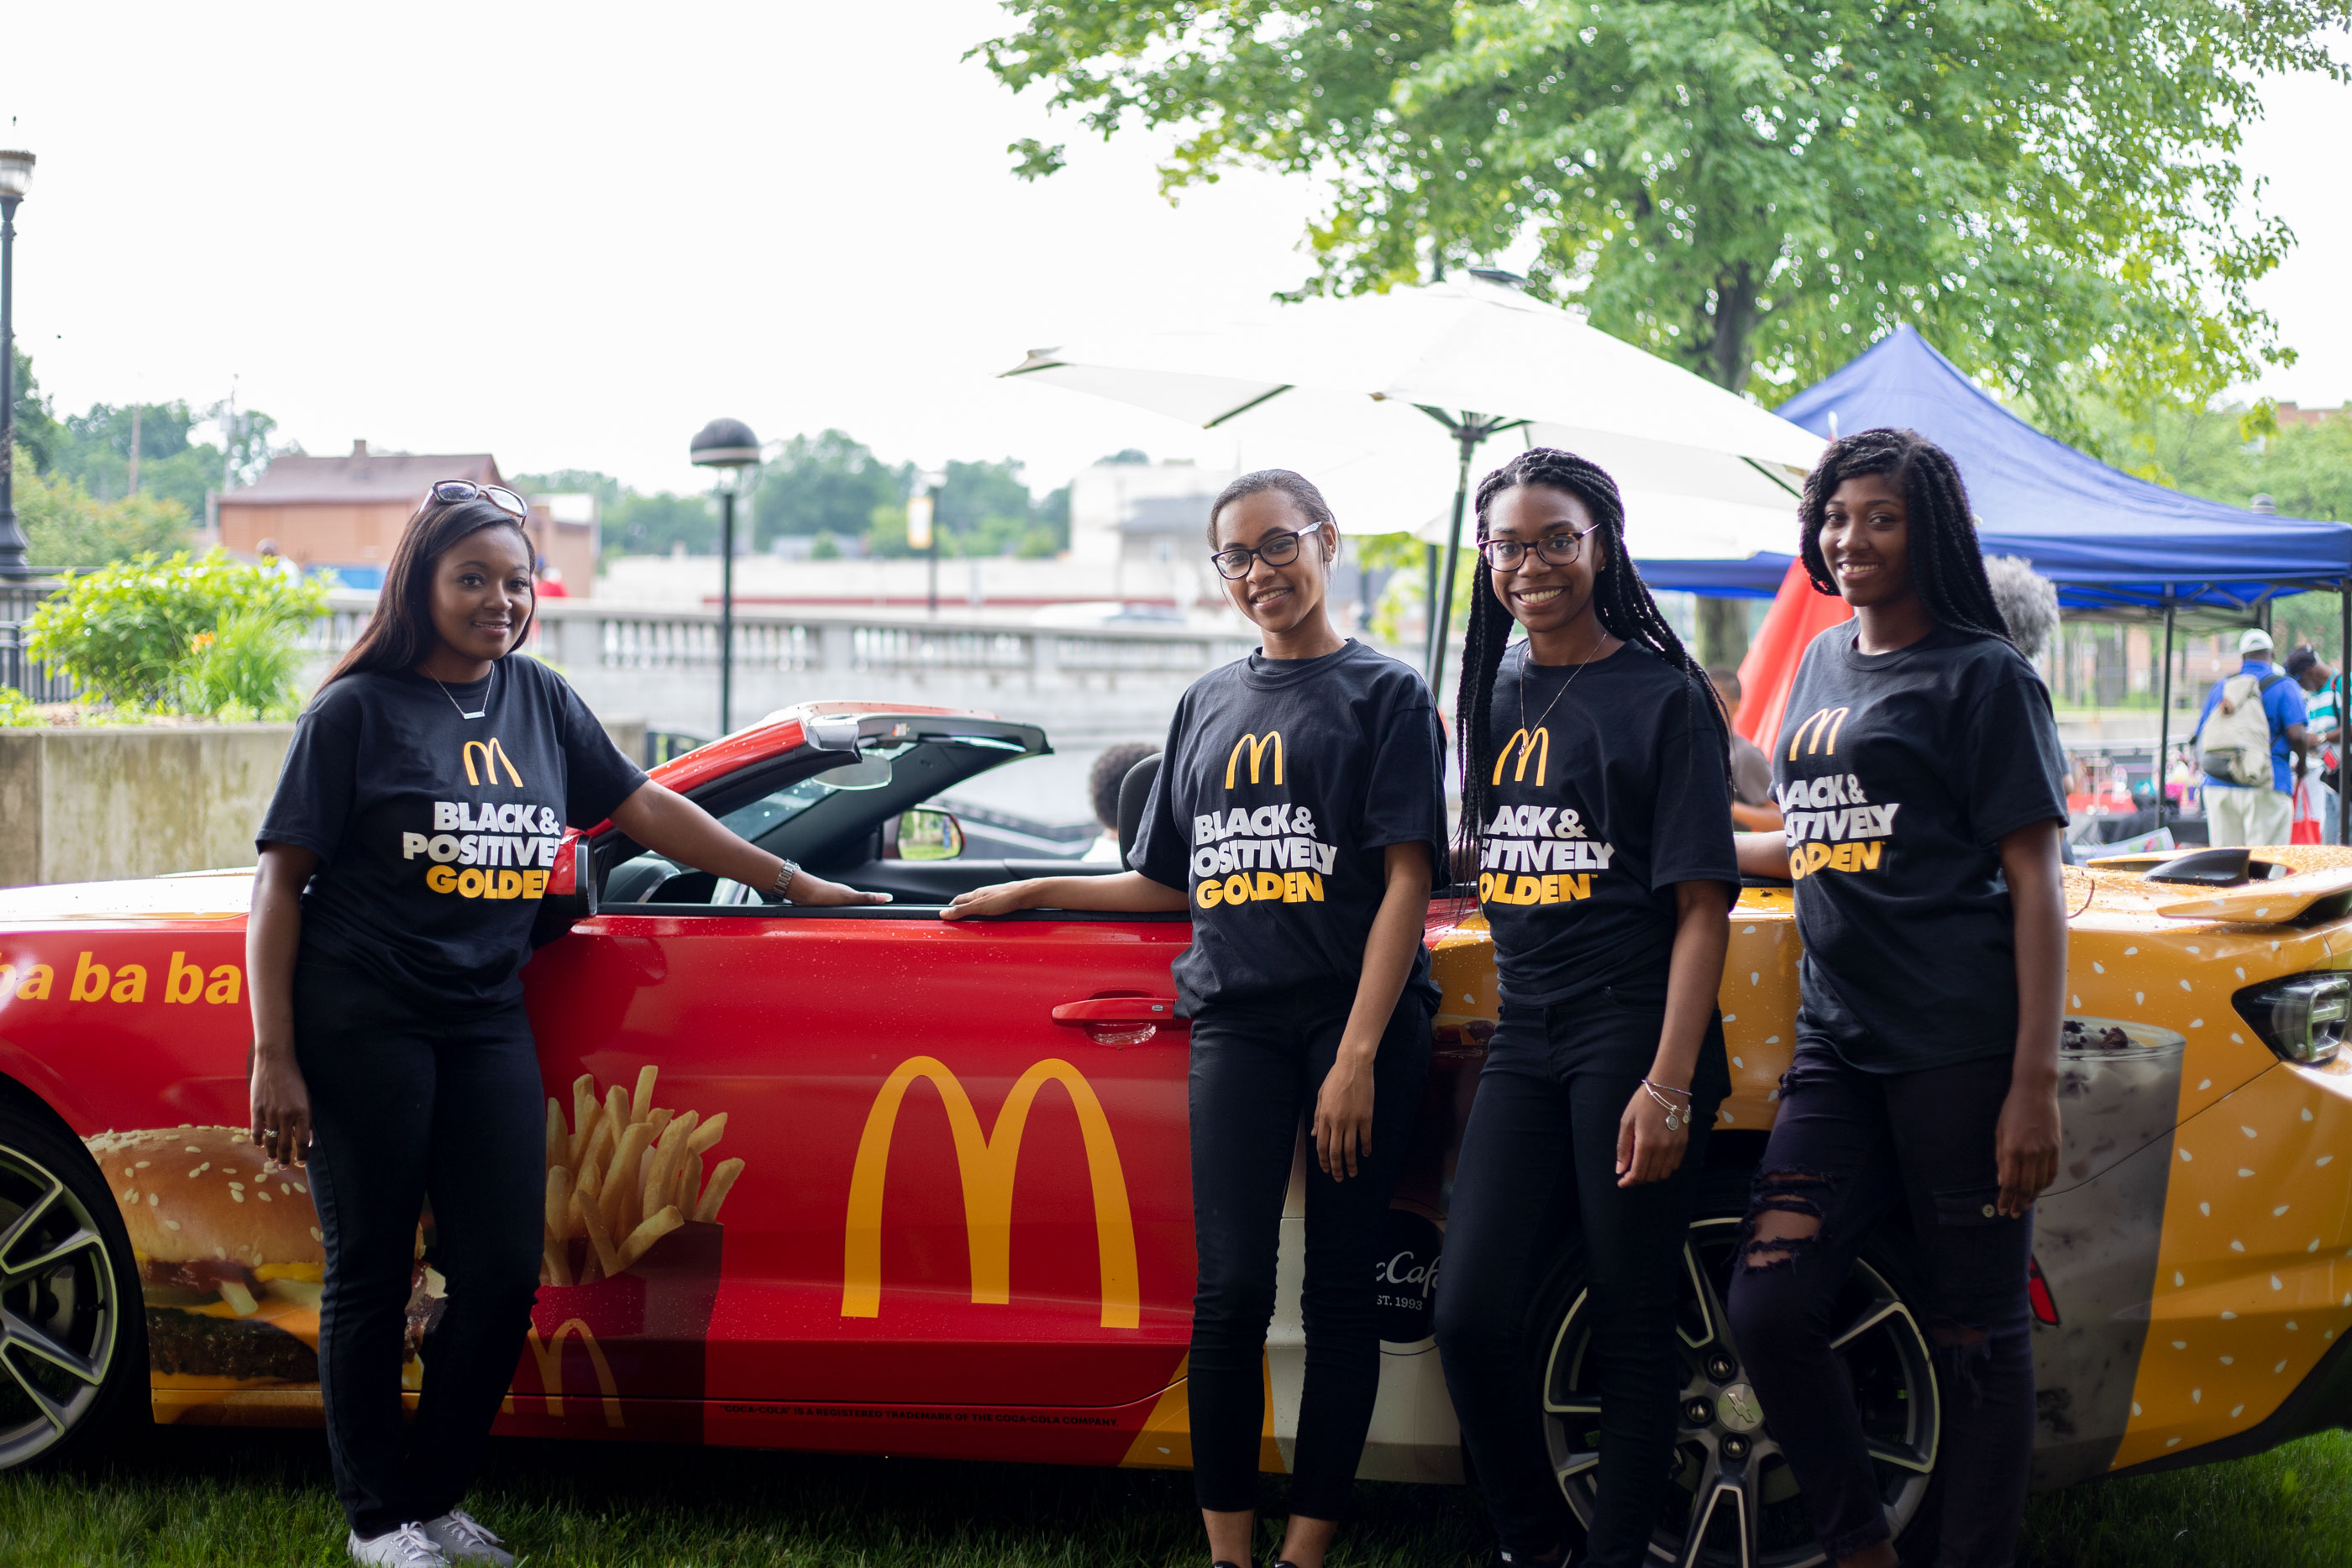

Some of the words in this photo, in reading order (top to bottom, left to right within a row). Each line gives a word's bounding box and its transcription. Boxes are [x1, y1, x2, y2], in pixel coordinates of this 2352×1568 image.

[1483, 805, 1555, 837] ACK
[402, 831, 560, 867] POSITIVE
[1190, 837, 1337, 877] OSITIVELY
[1196, 871, 1325, 909] GOLDEN
[1479, 873, 1591, 905] OLDEN
[69, 952, 147, 1002] ba
[164, 952, 241, 1004] ba
[1377, 1295, 1392, 1306] ST.
[1395, 1297, 1423, 1310] 1993
[794, 1407, 805, 1415] IS
[806, 1408, 814, 1416] A
[816, 1408, 883, 1419] REGISTERED
[885, 1410, 953, 1421] TRADEMARK
[954, 1413, 969, 1421] OF
[972, 1413, 993, 1423] THE
[995, 1414, 1060, 1424] COCA-COLA
[1062, 1416, 1120, 1427] COMPANY.
